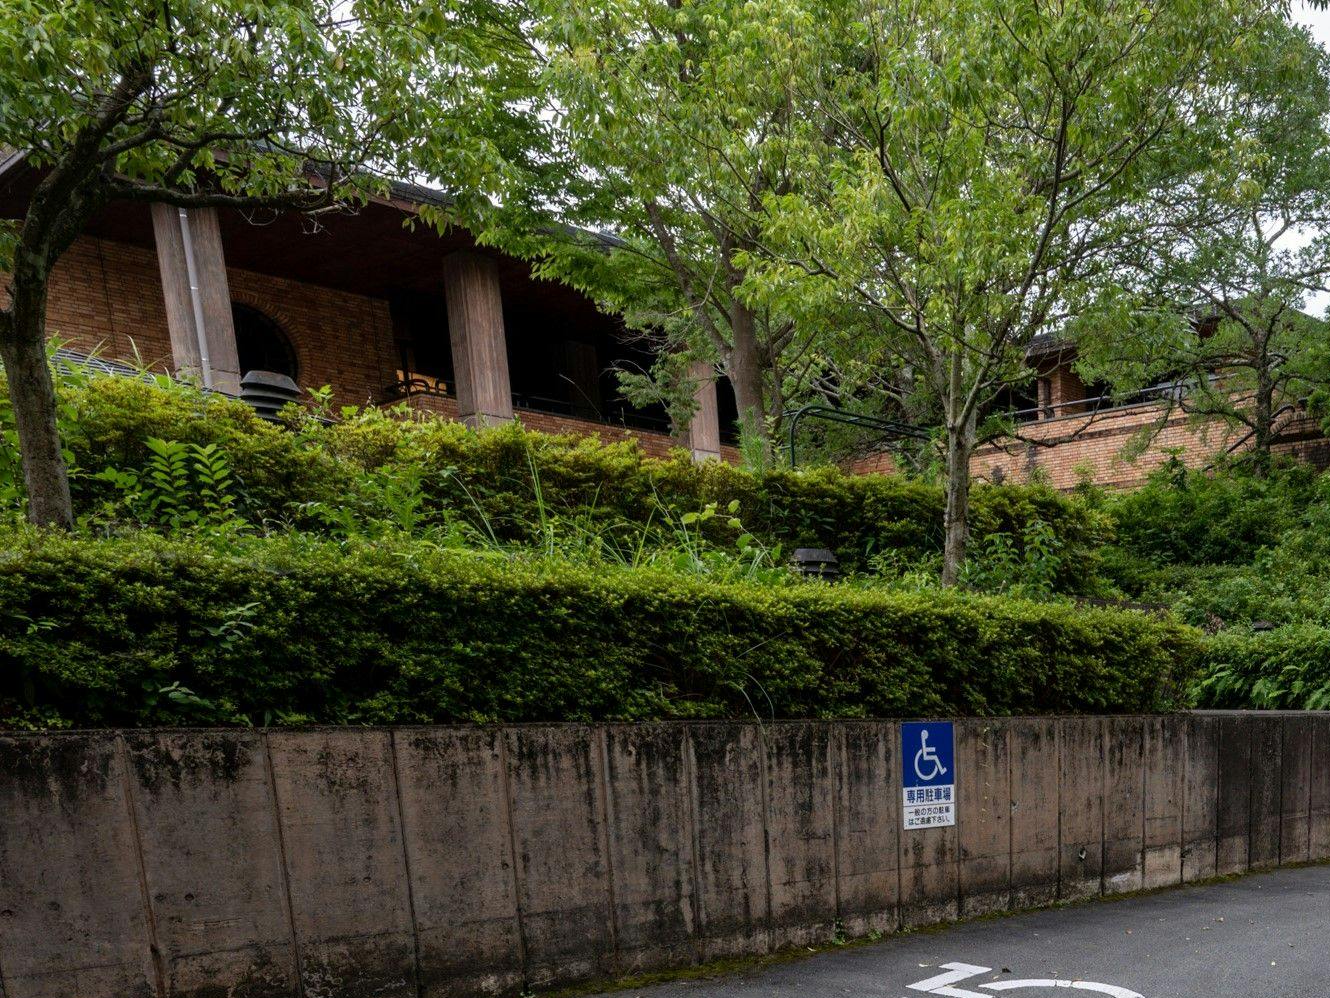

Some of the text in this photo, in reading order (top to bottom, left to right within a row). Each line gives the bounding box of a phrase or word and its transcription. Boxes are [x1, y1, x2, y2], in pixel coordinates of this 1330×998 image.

[907, 787, 951, 803] 専用駐車場
